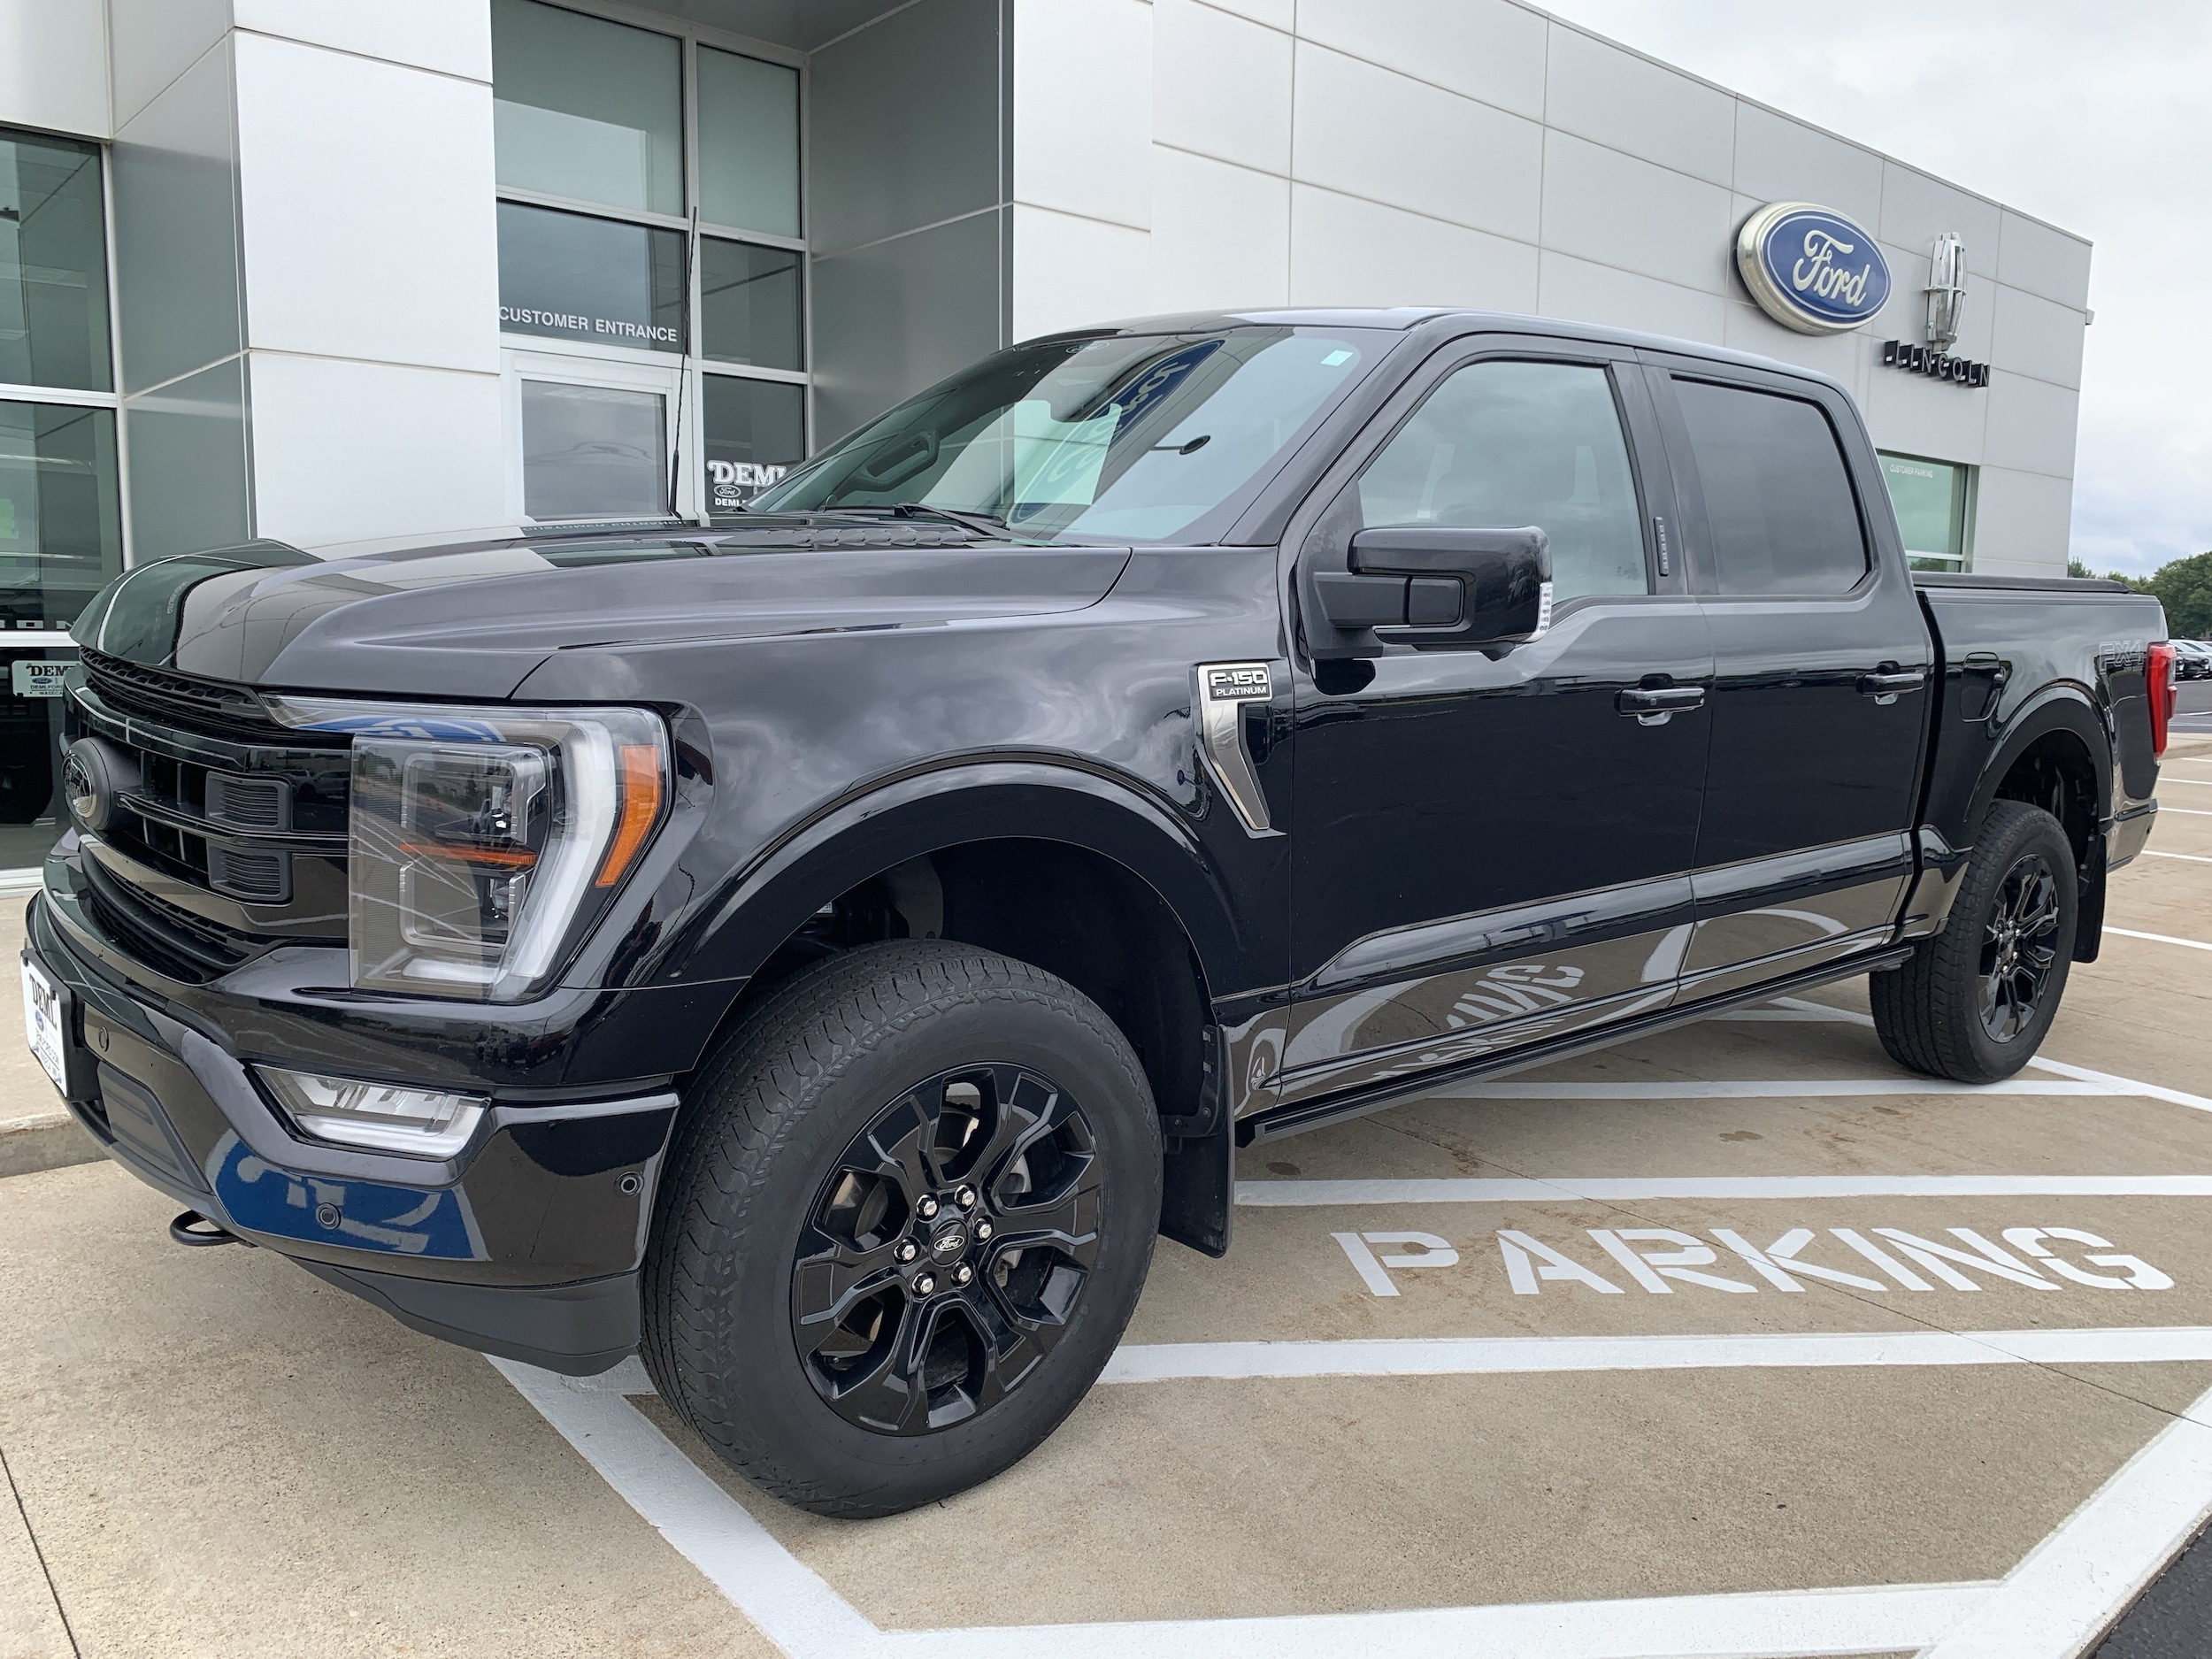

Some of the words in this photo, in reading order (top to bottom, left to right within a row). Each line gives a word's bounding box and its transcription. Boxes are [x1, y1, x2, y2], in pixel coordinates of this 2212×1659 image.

[1793, 230, 1871, 307] Ford
[499, 306, 588, 331] CUSTOMER
[595, 319, 678, 342] ENTRANCE
[1888, 340, 1990, 388] LINCOLN
[718, 487, 736, 495] Ford
[2099, 639, 2147, 675] FX4
[26, 665, 75, 677] DEM
[1210, 670, 1268, 687] F-150
[1216, 687, 1266, 696] PLATINUM
[940, 1238, 960, 1249] Ford
[1330, 1226, 2175, 1297] PARKING
